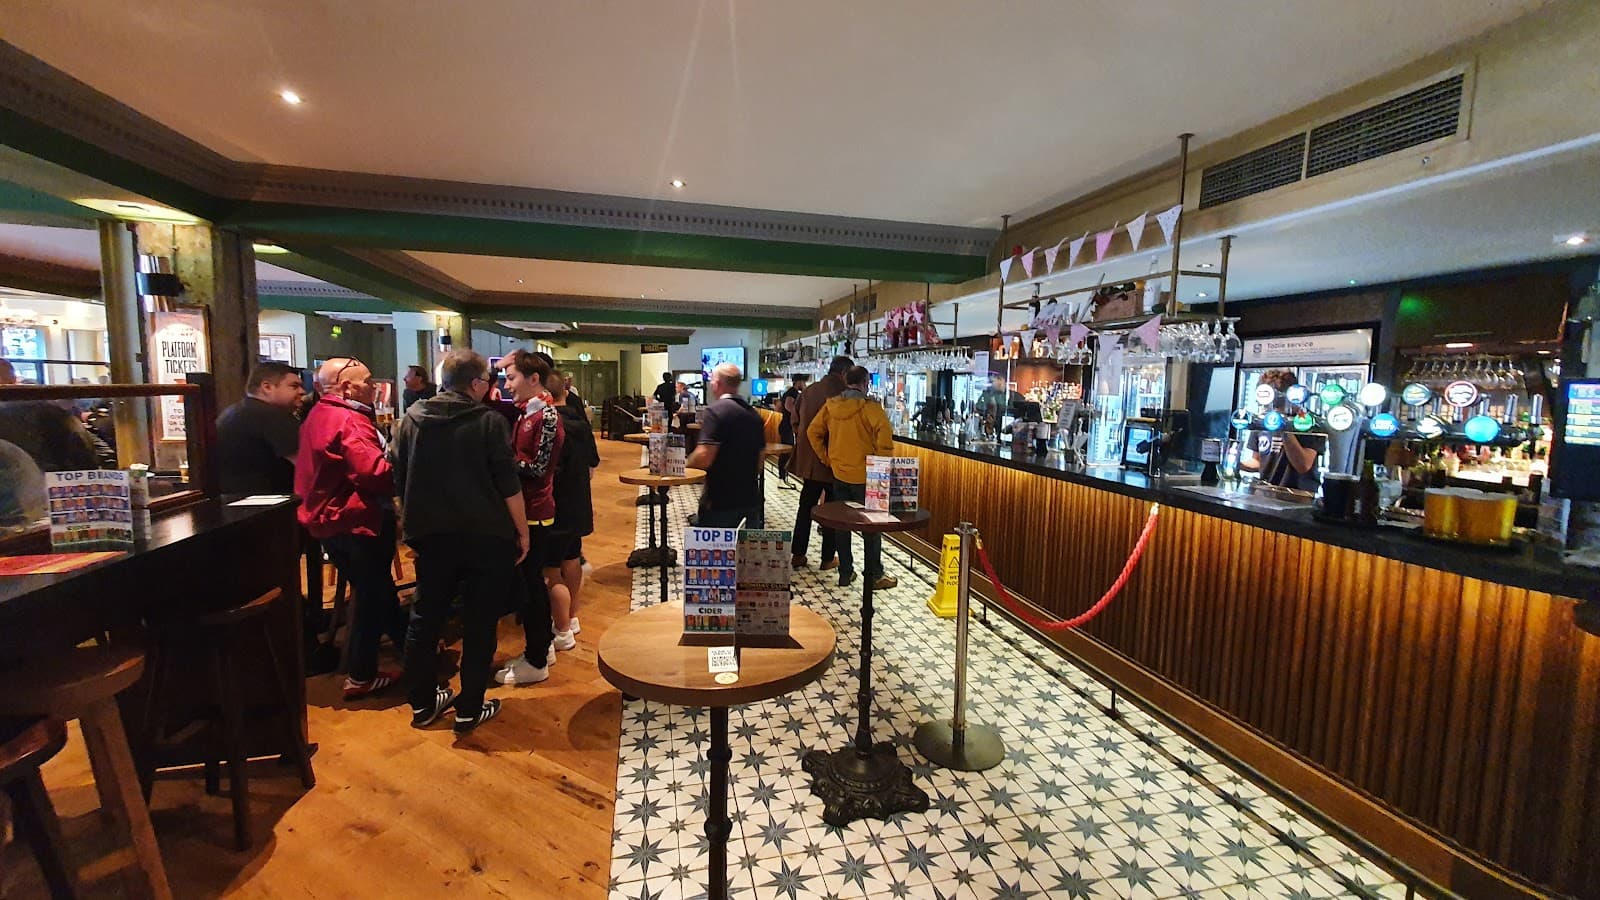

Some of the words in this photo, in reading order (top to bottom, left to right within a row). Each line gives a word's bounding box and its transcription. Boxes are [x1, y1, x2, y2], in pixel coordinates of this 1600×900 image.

[162, 341, 197, 358] PLATFORM
[165, 359, 197, 374] TICKETS
[56, 472, 83, 482] TOP
[693, 529, 720, 542] TOP
[698, 607, 722, 615] CIDER
